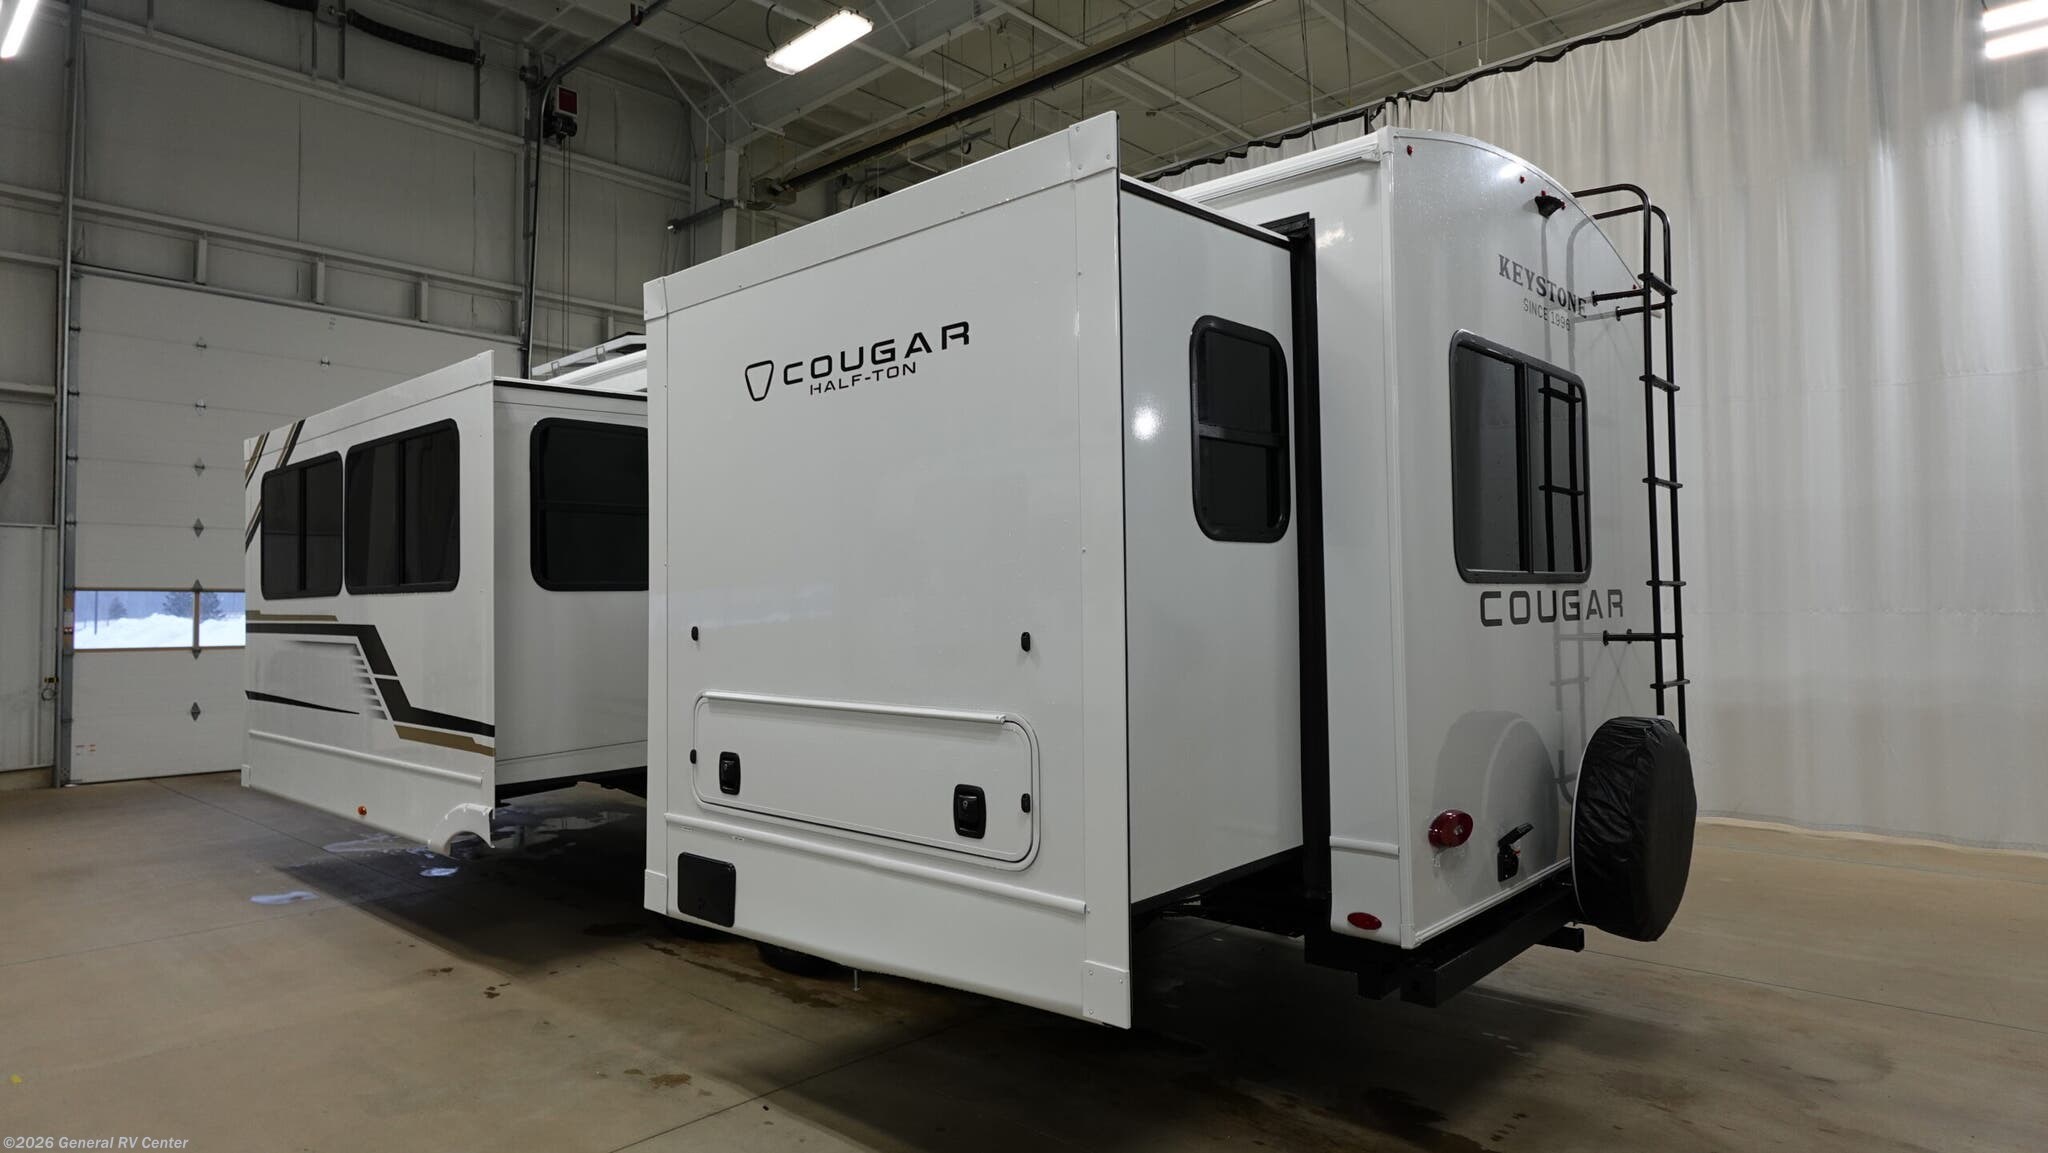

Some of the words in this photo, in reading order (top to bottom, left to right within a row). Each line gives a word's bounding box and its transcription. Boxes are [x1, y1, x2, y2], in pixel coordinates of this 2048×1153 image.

[1498, 254, 1587, 319] KEYSTONE
[1523, 298, 1548, 321] SINCE
[1550, 311, 1571, 332] 1996
[783, 321, 969, 386] COUGAR
[810, 362, 916, 395] HALF-TON
[1480, 589, 1623, 627] COUGAR
